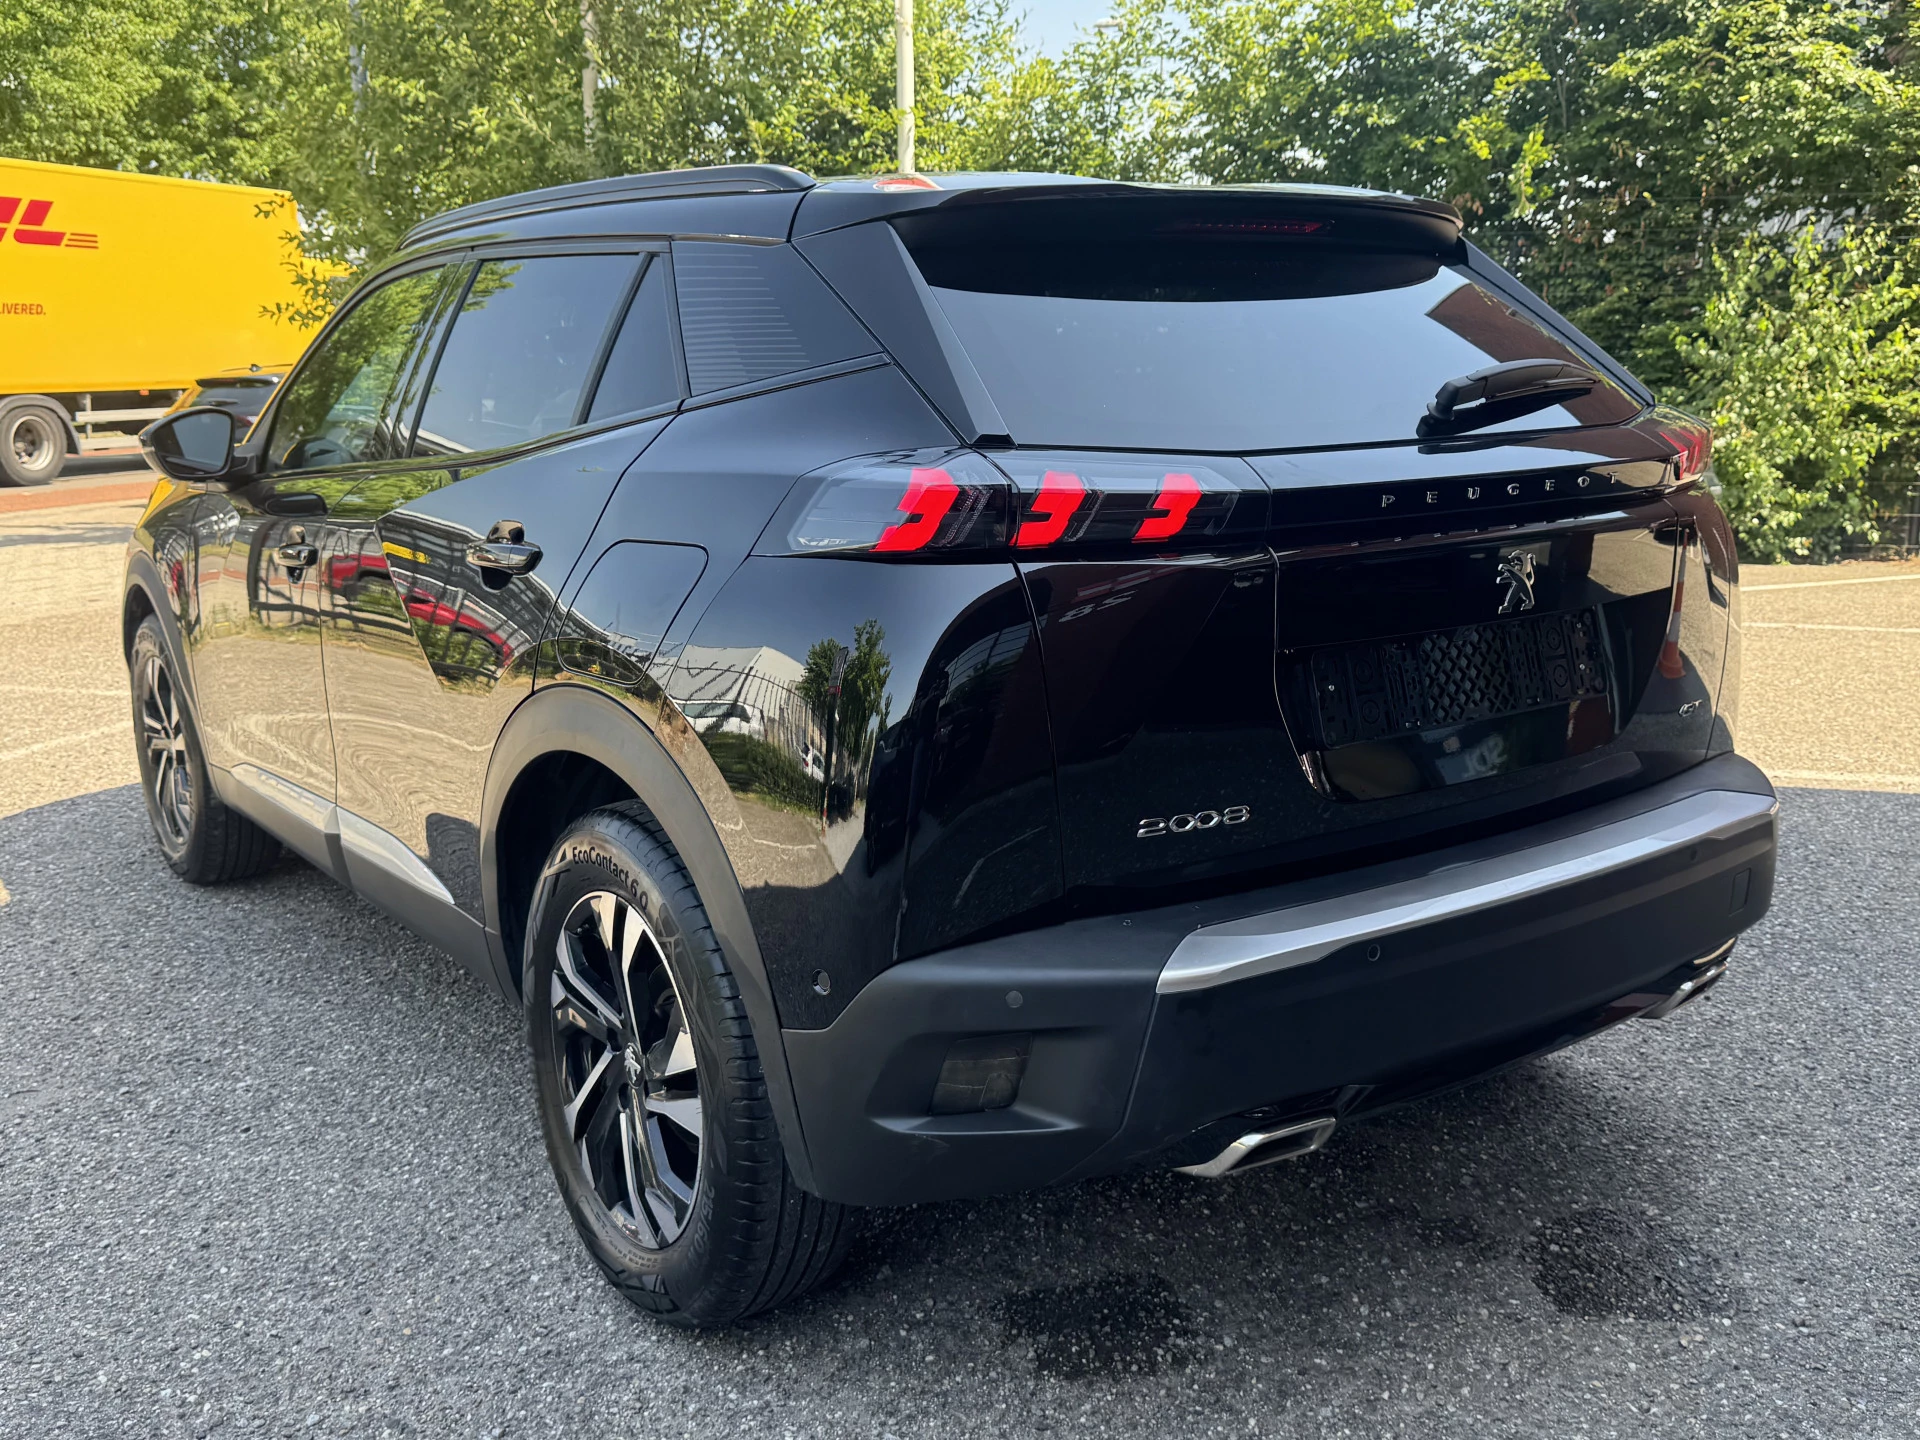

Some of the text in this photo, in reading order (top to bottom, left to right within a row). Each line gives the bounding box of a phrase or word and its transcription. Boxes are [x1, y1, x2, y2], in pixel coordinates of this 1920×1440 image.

[0, 302, 46, 315] IVERED.
[1381, 471, 1619, 508] PEUGEOT
[1136, 805, 1250, 838] 2008
[572, 846, 630, 888] EcoContact
[630, 878, 640, 898] 6
